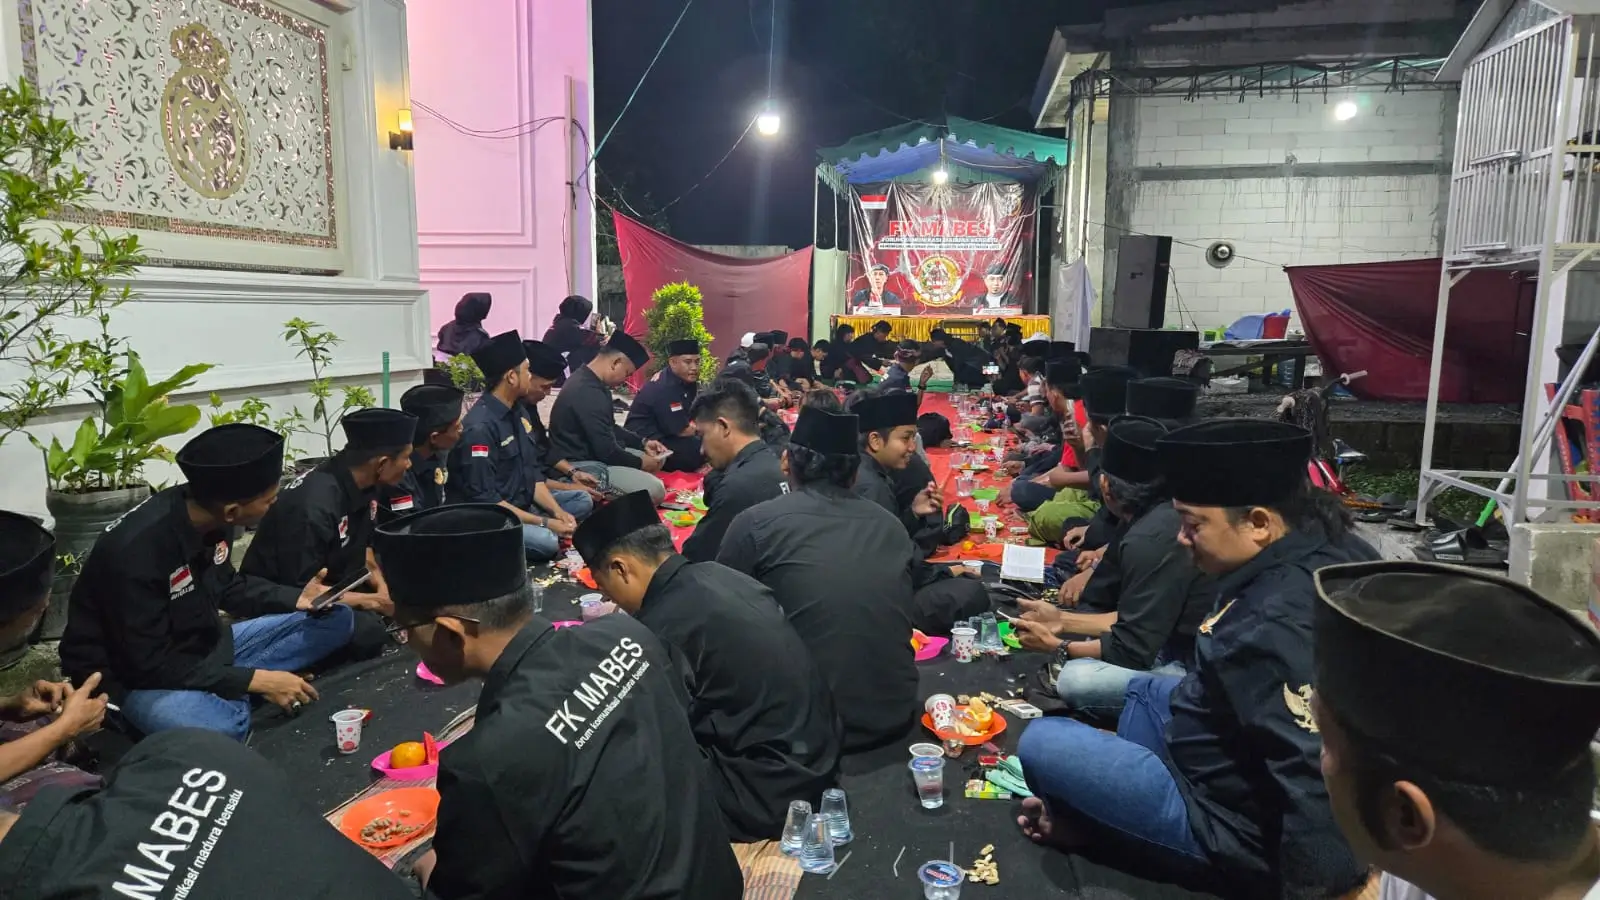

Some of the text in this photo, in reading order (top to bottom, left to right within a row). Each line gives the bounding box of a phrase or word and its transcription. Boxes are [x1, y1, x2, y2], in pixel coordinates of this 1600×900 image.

[889, 220, 992, 236] FK MABES
[545, 637, 643, 744] FK MABES
[112, 767, 227, 900] MABES
[193, 826, 223, 869] madura
[214, 788, 244, 827] bersatu
